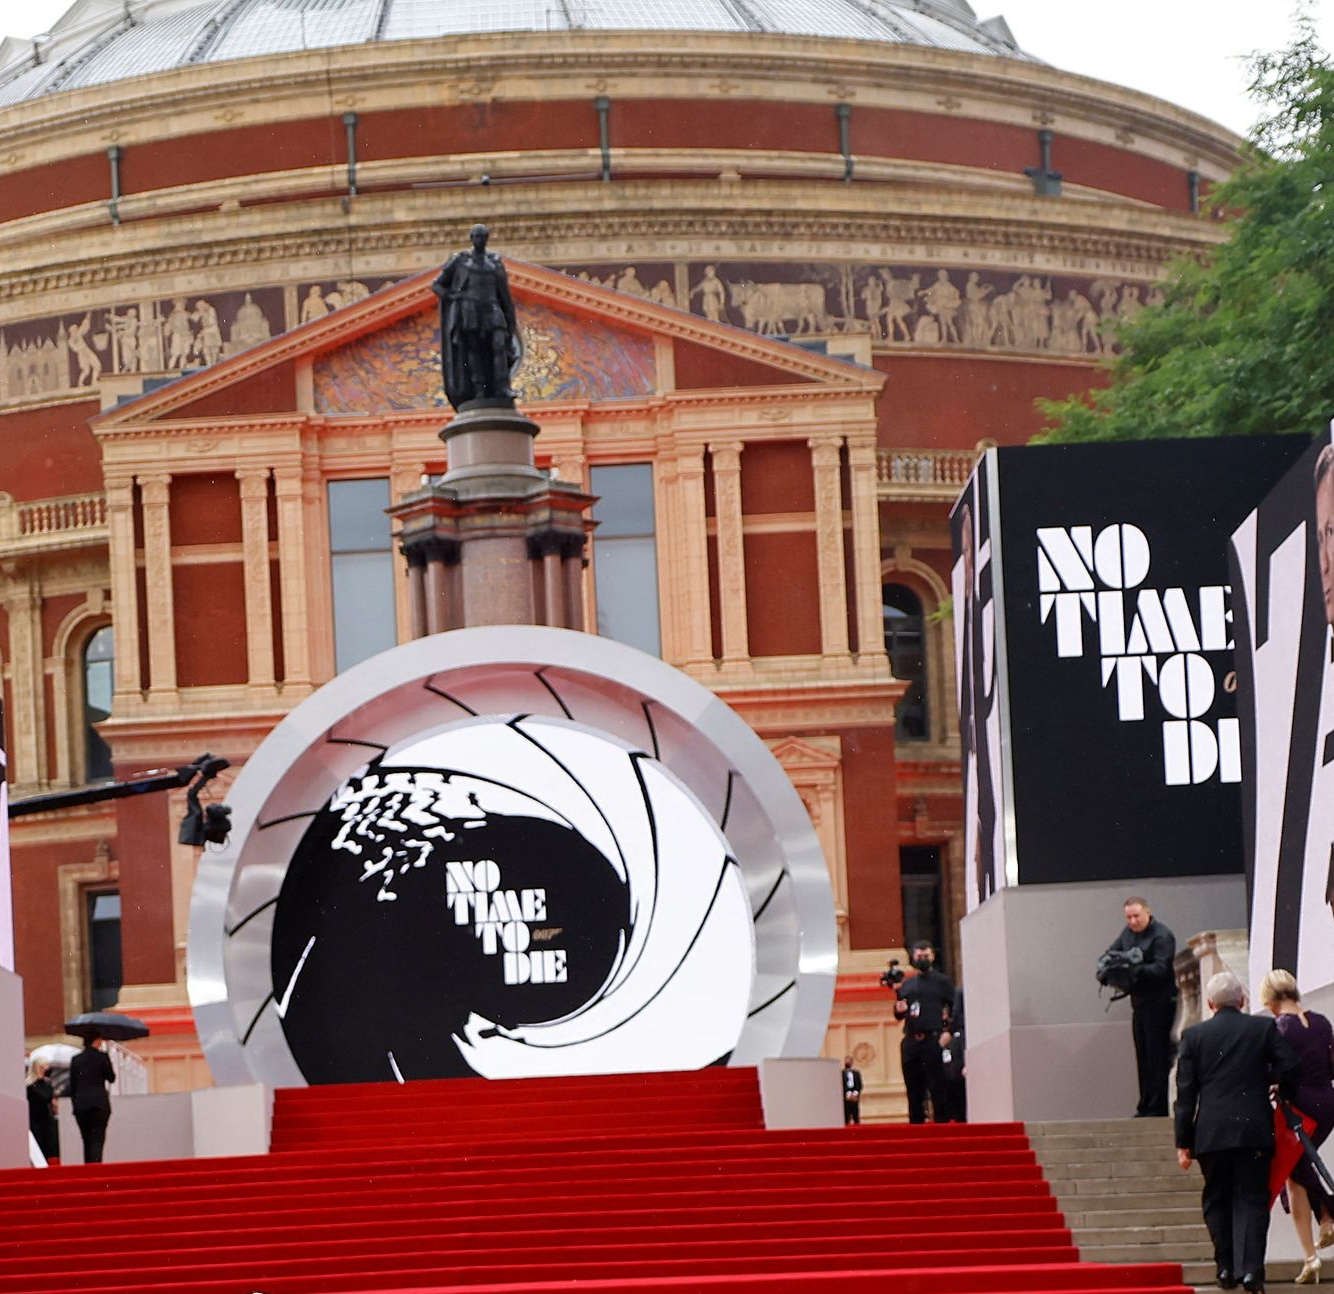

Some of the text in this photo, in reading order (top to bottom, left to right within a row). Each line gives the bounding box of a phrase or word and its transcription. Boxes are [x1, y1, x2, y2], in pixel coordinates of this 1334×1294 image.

[1037, 523, 1151, 592] NO
[1101, 652, 1215, 721] TO
[1162, 717, 1243, 786] DI
[446, 860, 501, 893] NO
[447, 888, 547, 926] TIME
[475, 921, 530, 955] TO
[504, 949, 568, 986] DIE
